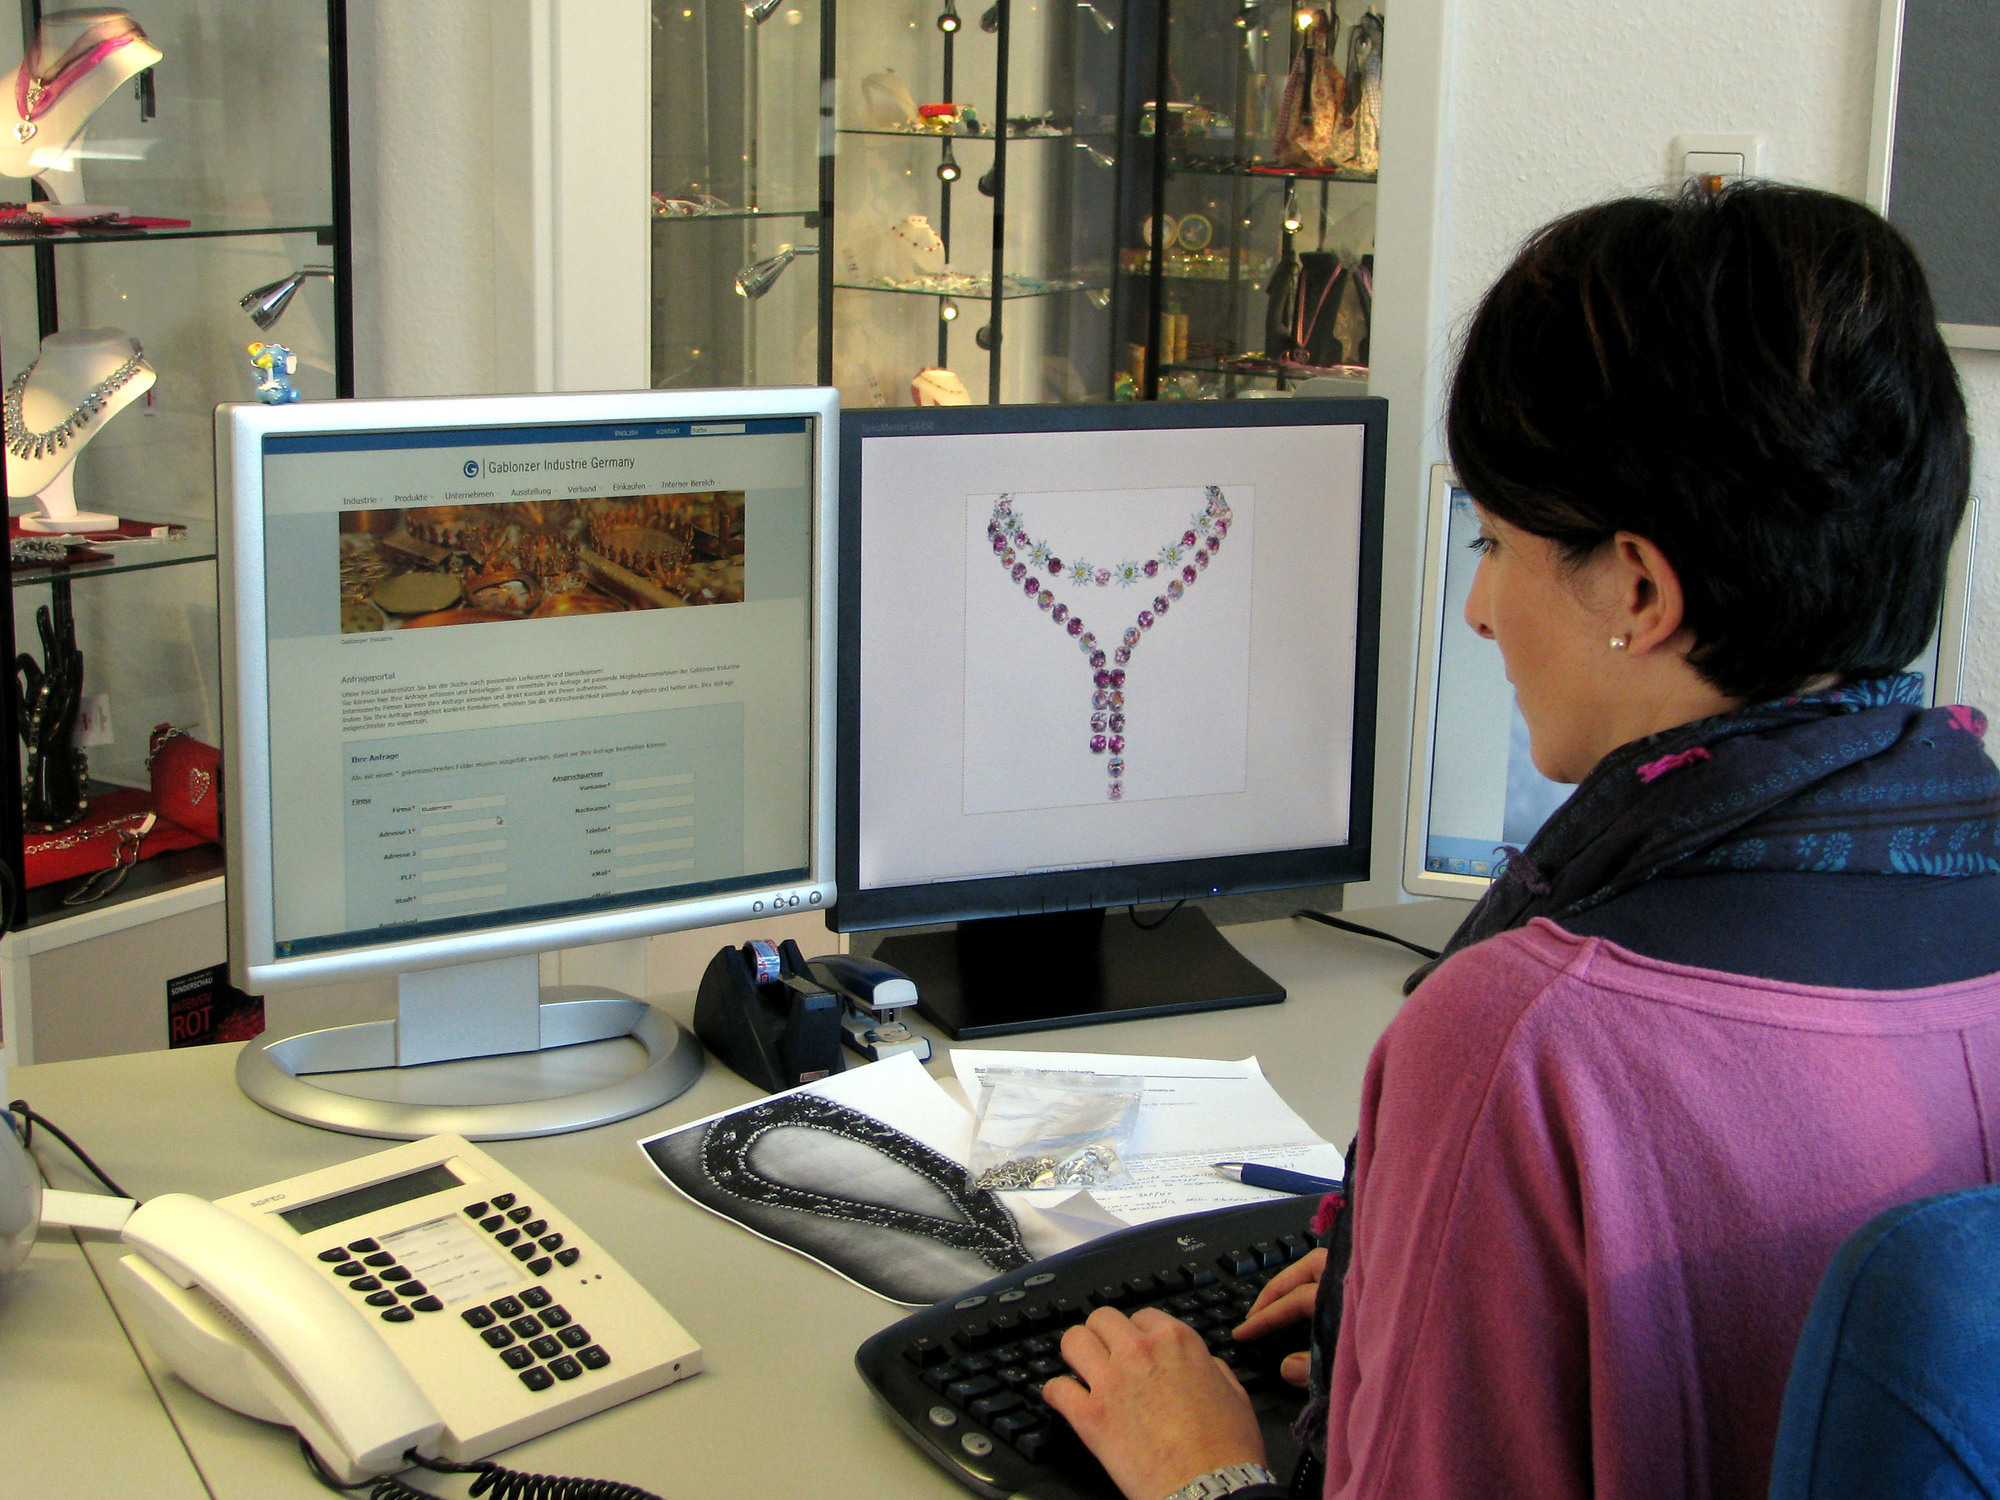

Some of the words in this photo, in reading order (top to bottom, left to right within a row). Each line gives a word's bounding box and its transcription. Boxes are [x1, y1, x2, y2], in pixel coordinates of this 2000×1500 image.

[488, 461, 540, 474] Gablonzer
[544, 459, 588, 471] Industrie
[590, 456, 636, 470] Germany
[343, 497, 378, 505] Industrie
[395, 494, 428, 502] Produkte
[445, 491, 494, 500] Unternehmen
[511, 488, 552, 497] Ausstellung
[567, 484, 597, 494] Verband
[612, 482, 646, 491] Einkaufen
[662, 480, 690, 488] Interner
[690, 479, 716, 487] Bereich
[342, 672, 396, 684] Anfrageportal
[369, 753, 400, 762] Anfrage
[171, 976, 213, 996] SONDERSCHAU
[172, 1005, 214, 1042] ROT
[504, 1302, 516, 1312] 2
